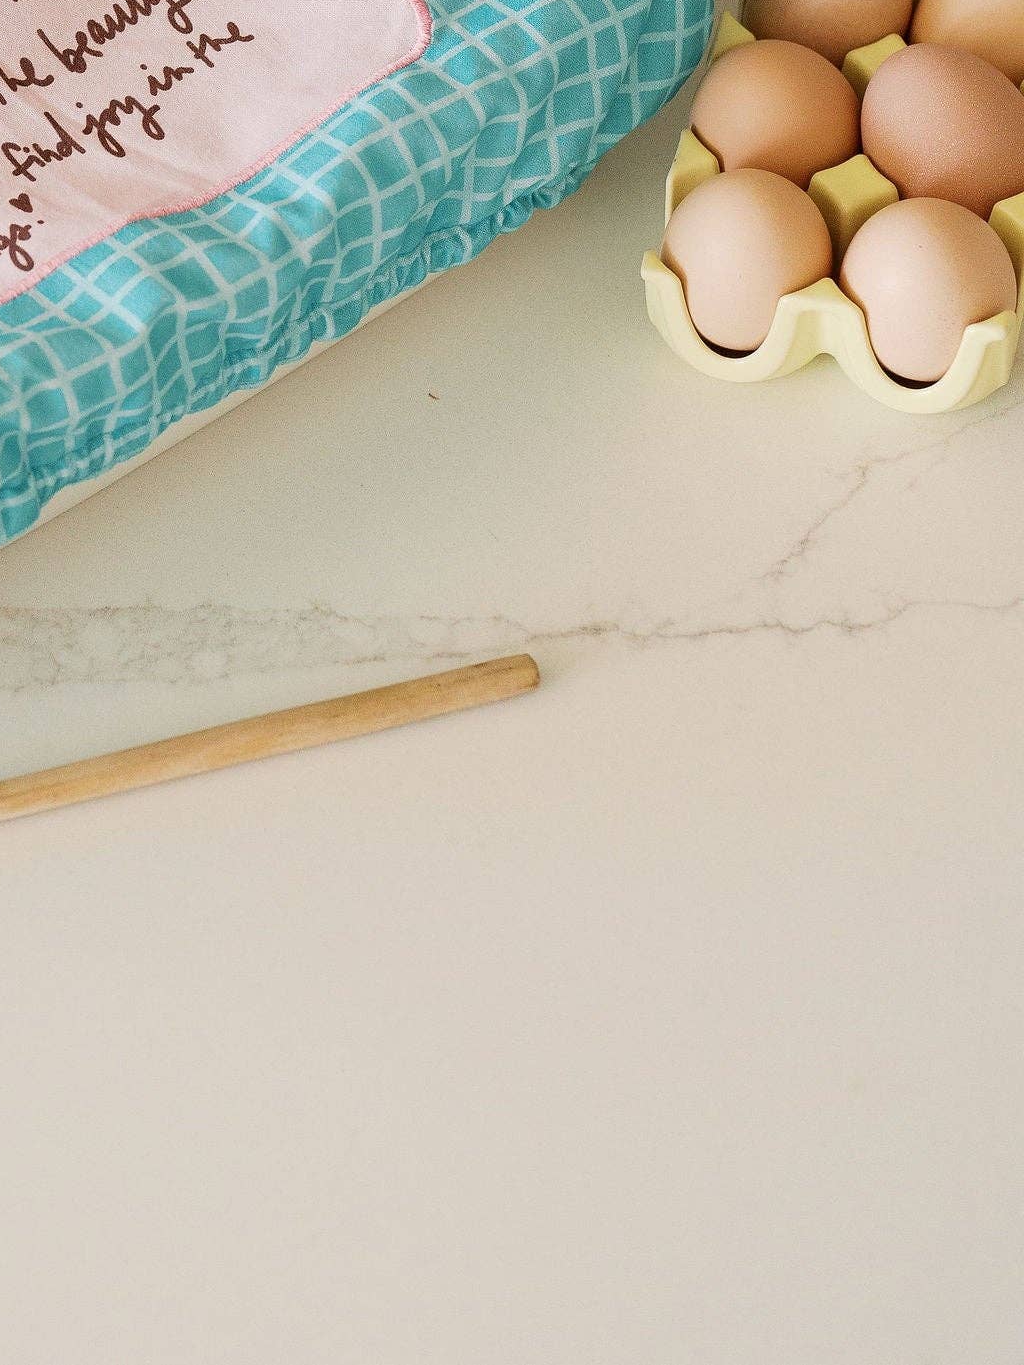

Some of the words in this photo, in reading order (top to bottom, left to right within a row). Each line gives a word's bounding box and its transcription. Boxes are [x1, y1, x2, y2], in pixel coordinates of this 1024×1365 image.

[0, 111, 87, 183] find
[75, 95, 166, 159] joy
[139, 63, 195, 97] in
[185, 21, 255, 69] the
